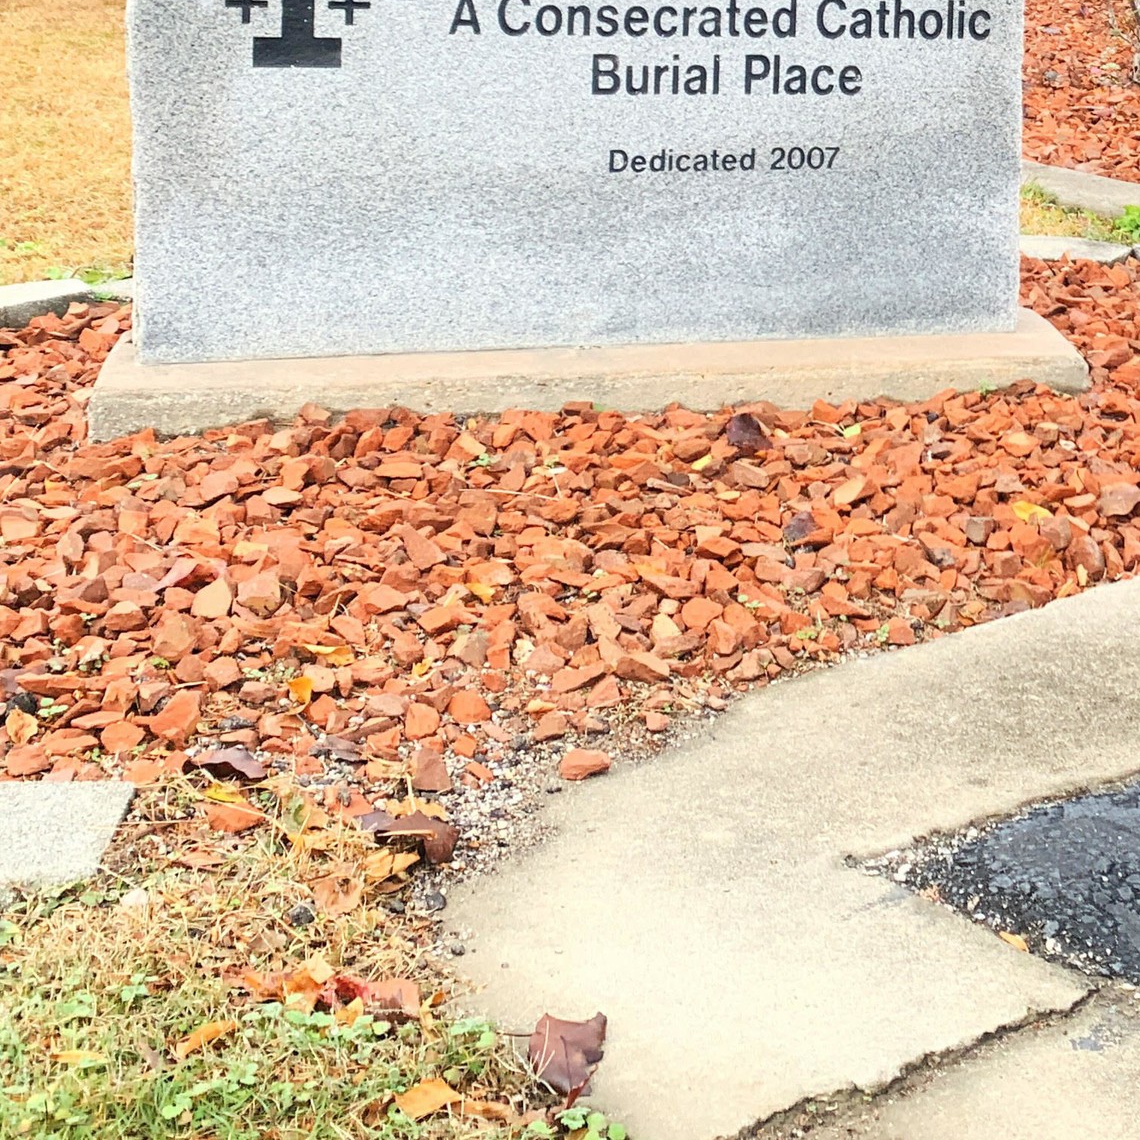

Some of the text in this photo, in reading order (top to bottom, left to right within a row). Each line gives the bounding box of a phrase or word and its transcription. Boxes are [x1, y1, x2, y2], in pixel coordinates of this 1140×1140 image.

[591, 53, 863, 96] Burial Place
[608, 146, 841, 173] Dedicated 2007
